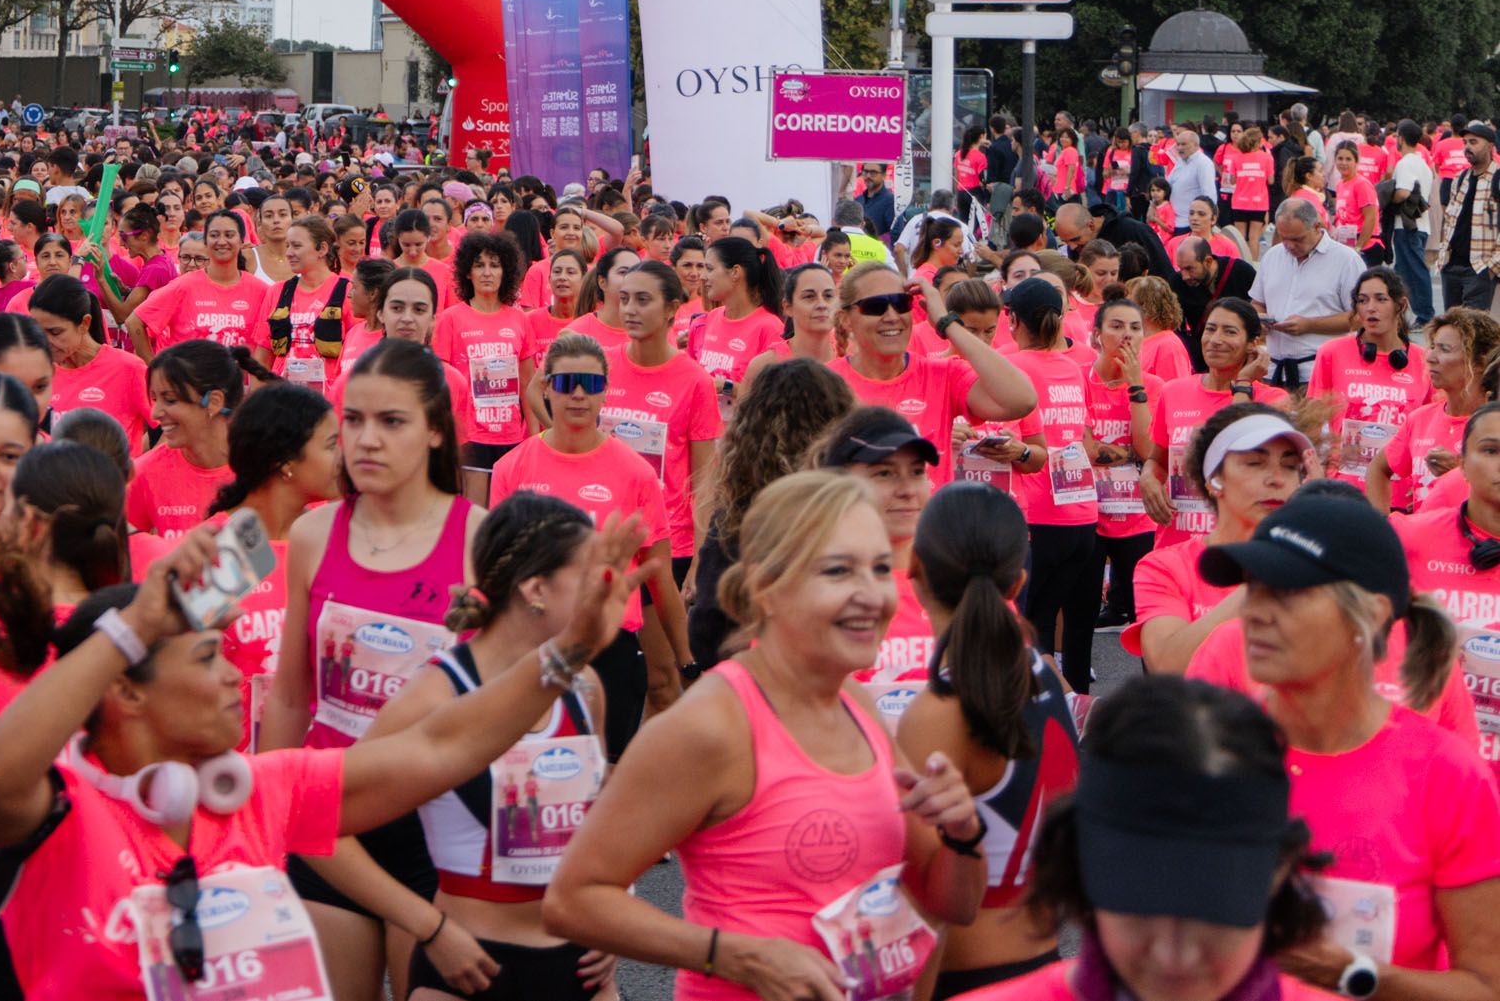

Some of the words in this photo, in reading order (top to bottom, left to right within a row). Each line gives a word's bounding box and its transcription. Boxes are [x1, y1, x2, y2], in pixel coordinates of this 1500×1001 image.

[849, 86, 901, 99] OYSHO
[774, 113, 902, 135] CORREDORAS
[197, 313, 245, 328] CARRERA
[467, 342, 514, 359] CARRERA
[489, 379, 508, 389] 016
[1048, 385, 1083, 403] SOMOS
[1348, 383, 1407, 404] CARRERA
[476, 407, 512, 423] MUJER
[965, 471, 992, 482] 016
[1065, 470, 1083, 481] 016
[1114, 481, 1135, 491] 016
[158, 504, 197, 516] OYSHO
[1427, 560, 1477, 576] OYSHO
[351, 669, 402, 696] 016
[541, 803, 585, 829] 016
[879, 938, 917, 975] 016
